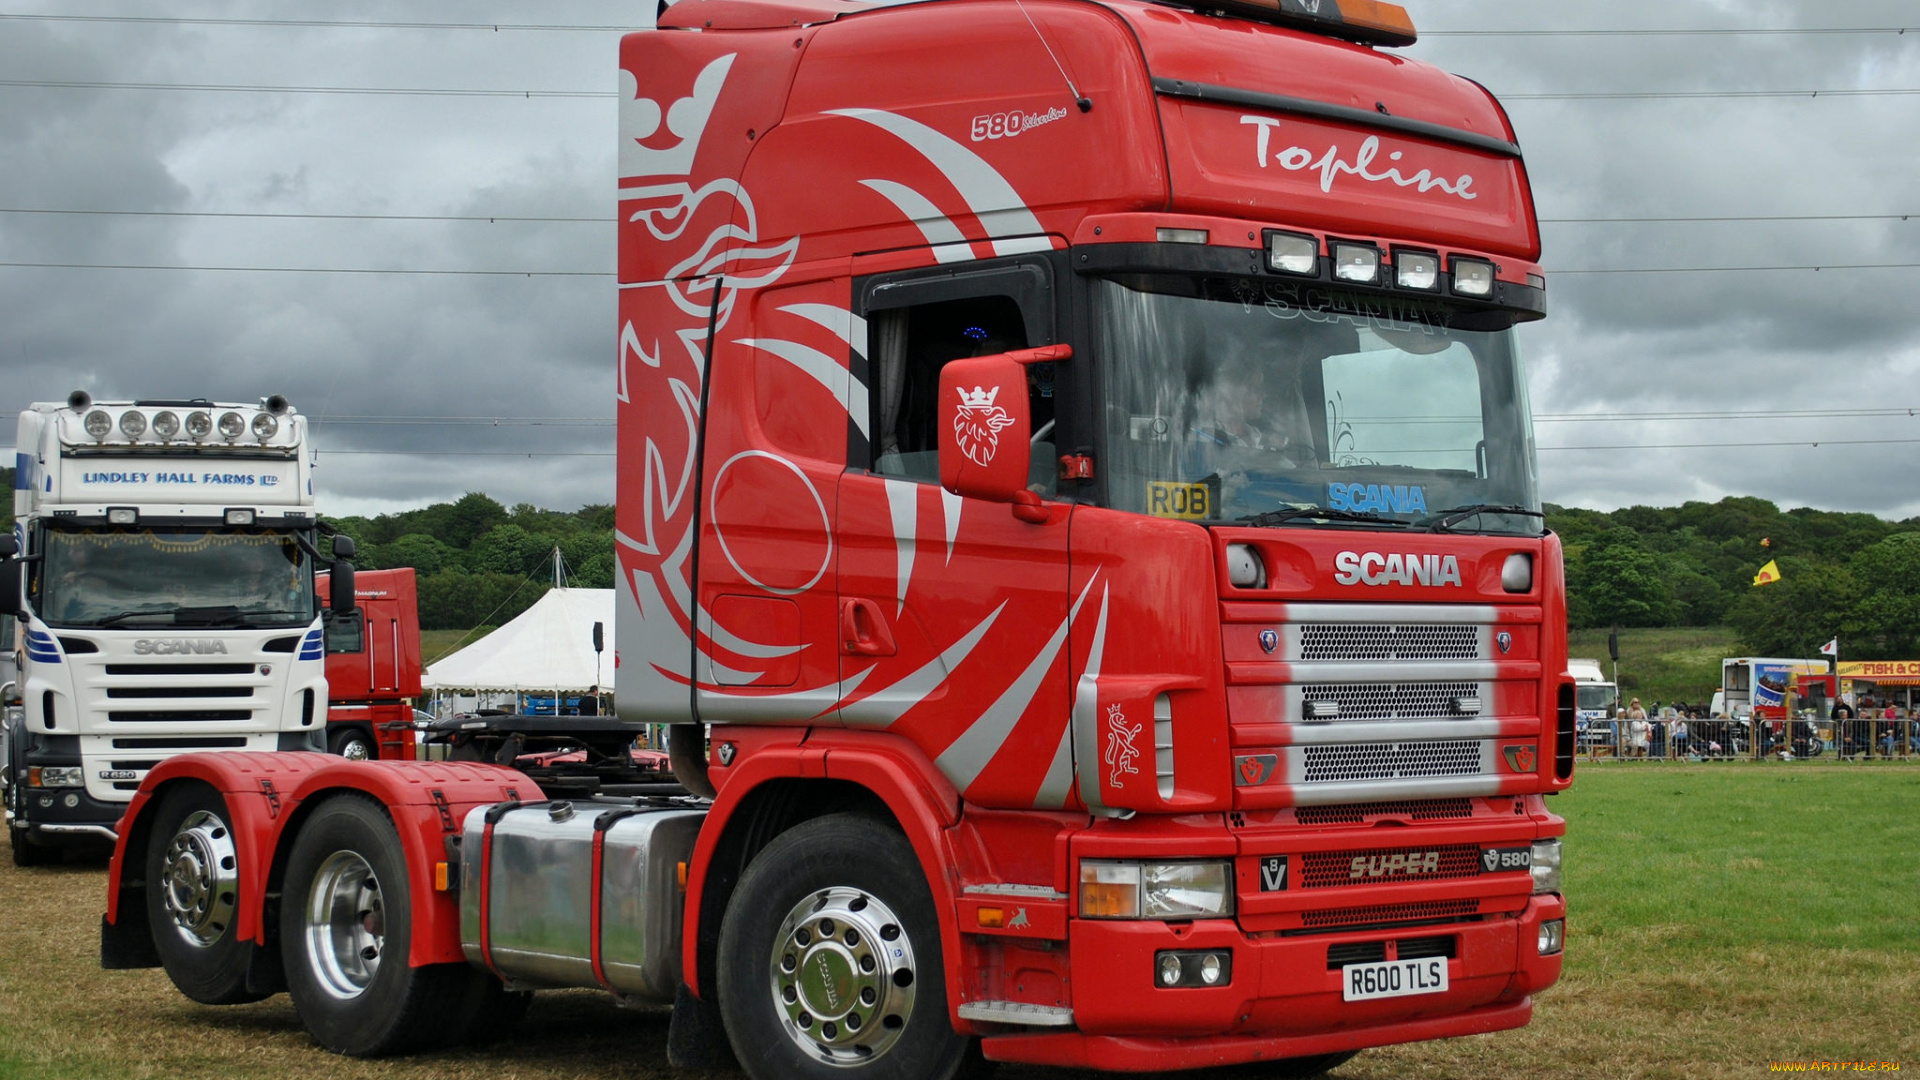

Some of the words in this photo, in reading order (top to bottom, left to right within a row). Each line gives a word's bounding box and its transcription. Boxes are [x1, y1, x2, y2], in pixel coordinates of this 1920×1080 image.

[971, 110, 1024, 142] 580
[1240, 115, 1477, 200] Topline
[1263, 282, 1434, 336] SCANIA
[83, 472, 149, 483] LINDLEY
[156, 473, 196, 484] HALL
[203, 473, 255, 486] FARMS
[1151, 486, 1206, 514] ROB
[1328, 482, 1427, 514] SCANIA
[1334, 550, 1462, 587] SCANIA
[134, 639, 228, 655] SCANIA
[1863, 663, 1894, 675] FISH
[1896, 663, 1906, 674] &
[1350, 852, 1439, 878] SUPER
[1501, 852, 1530, 867] 580
[1351, 965, 1400, 995] R600
[1406, 962, 1441, 989] TLS
